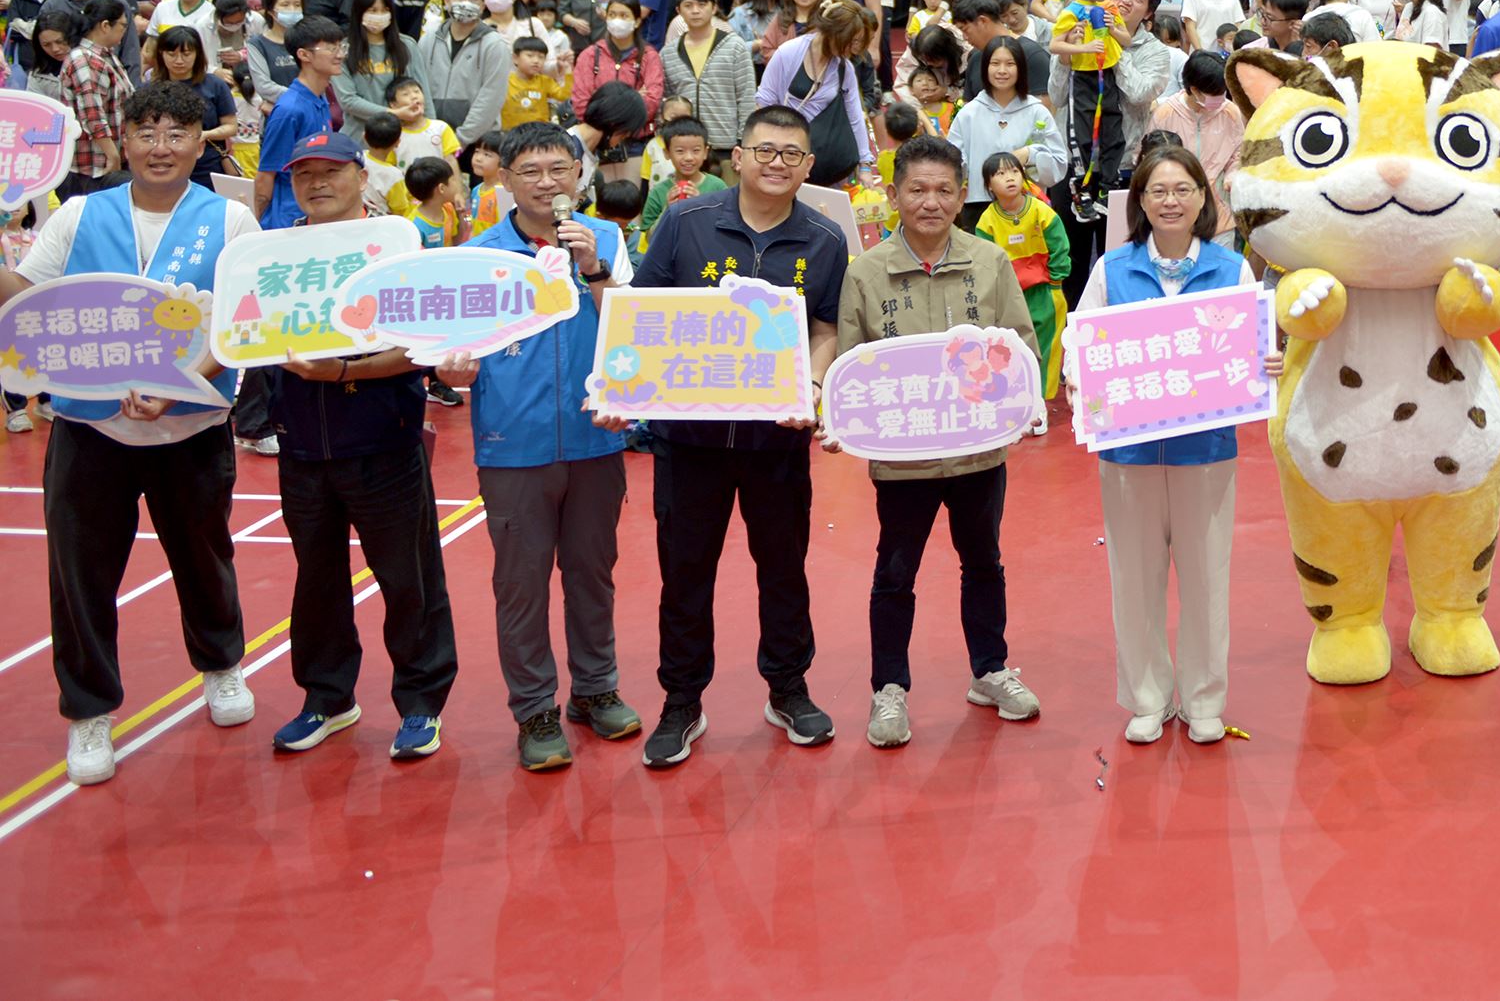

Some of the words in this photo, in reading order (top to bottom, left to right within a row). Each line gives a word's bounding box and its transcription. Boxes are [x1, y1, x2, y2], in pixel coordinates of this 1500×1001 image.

[378, 281, 535, 324] 照南國小
[14, 305, 141, 338] 幸福照南
[630, 310, 747, 347] 最棒的
[37, 340, 163, 371] 溫暖同行
[1085, 326, 1203, 373] 照南有愛
[660, 352, 777, 389] 在這裡
[1105, 357, 1250, 406] 幸福每一步
[838, 372, 961, 409] 全家齊力
[876, 401, 999, 439] 愛無止境
